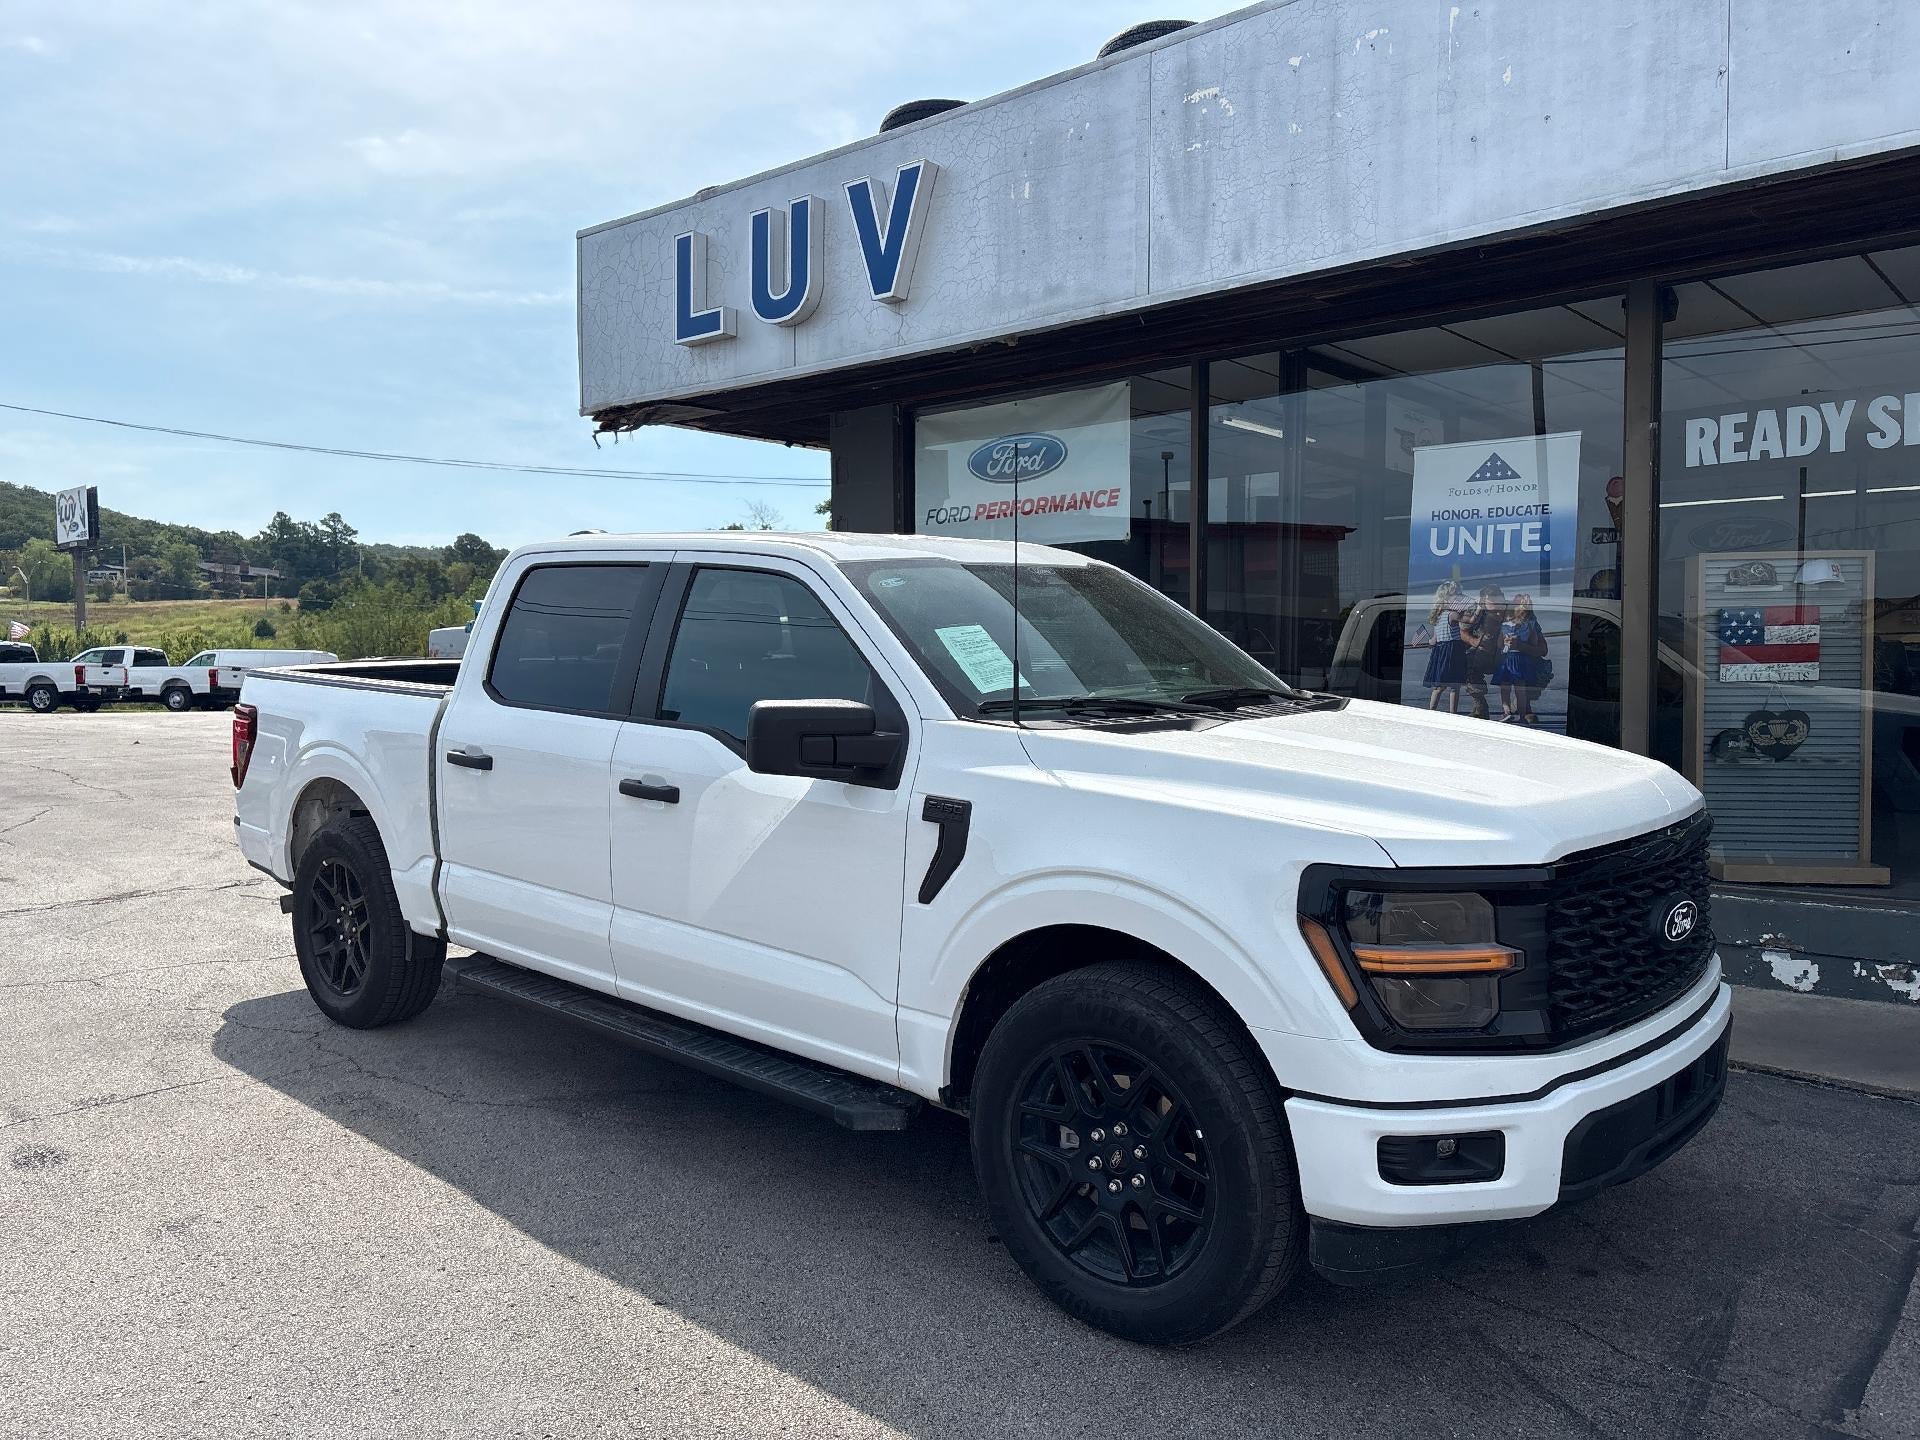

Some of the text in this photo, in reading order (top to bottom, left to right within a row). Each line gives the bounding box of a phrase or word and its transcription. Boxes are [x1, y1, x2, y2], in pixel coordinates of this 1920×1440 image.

[674, 158, 938, 347] LUV
[1685, 400, 1857, 468] READY
[987, 442, 1047, 475] Ford
[925, 488, 1121, 526] FORD PERFORMANCE
[1448, 484, 1539, 497] FOLDS of HONOR
[59, 502, 77, 523] LUV
[1431, 503, 1553, 522] HONOR. EDUCATE.
[1429, 521, 1552, 557] UNITE.
[1671, 906, 1693, 937] Ford
